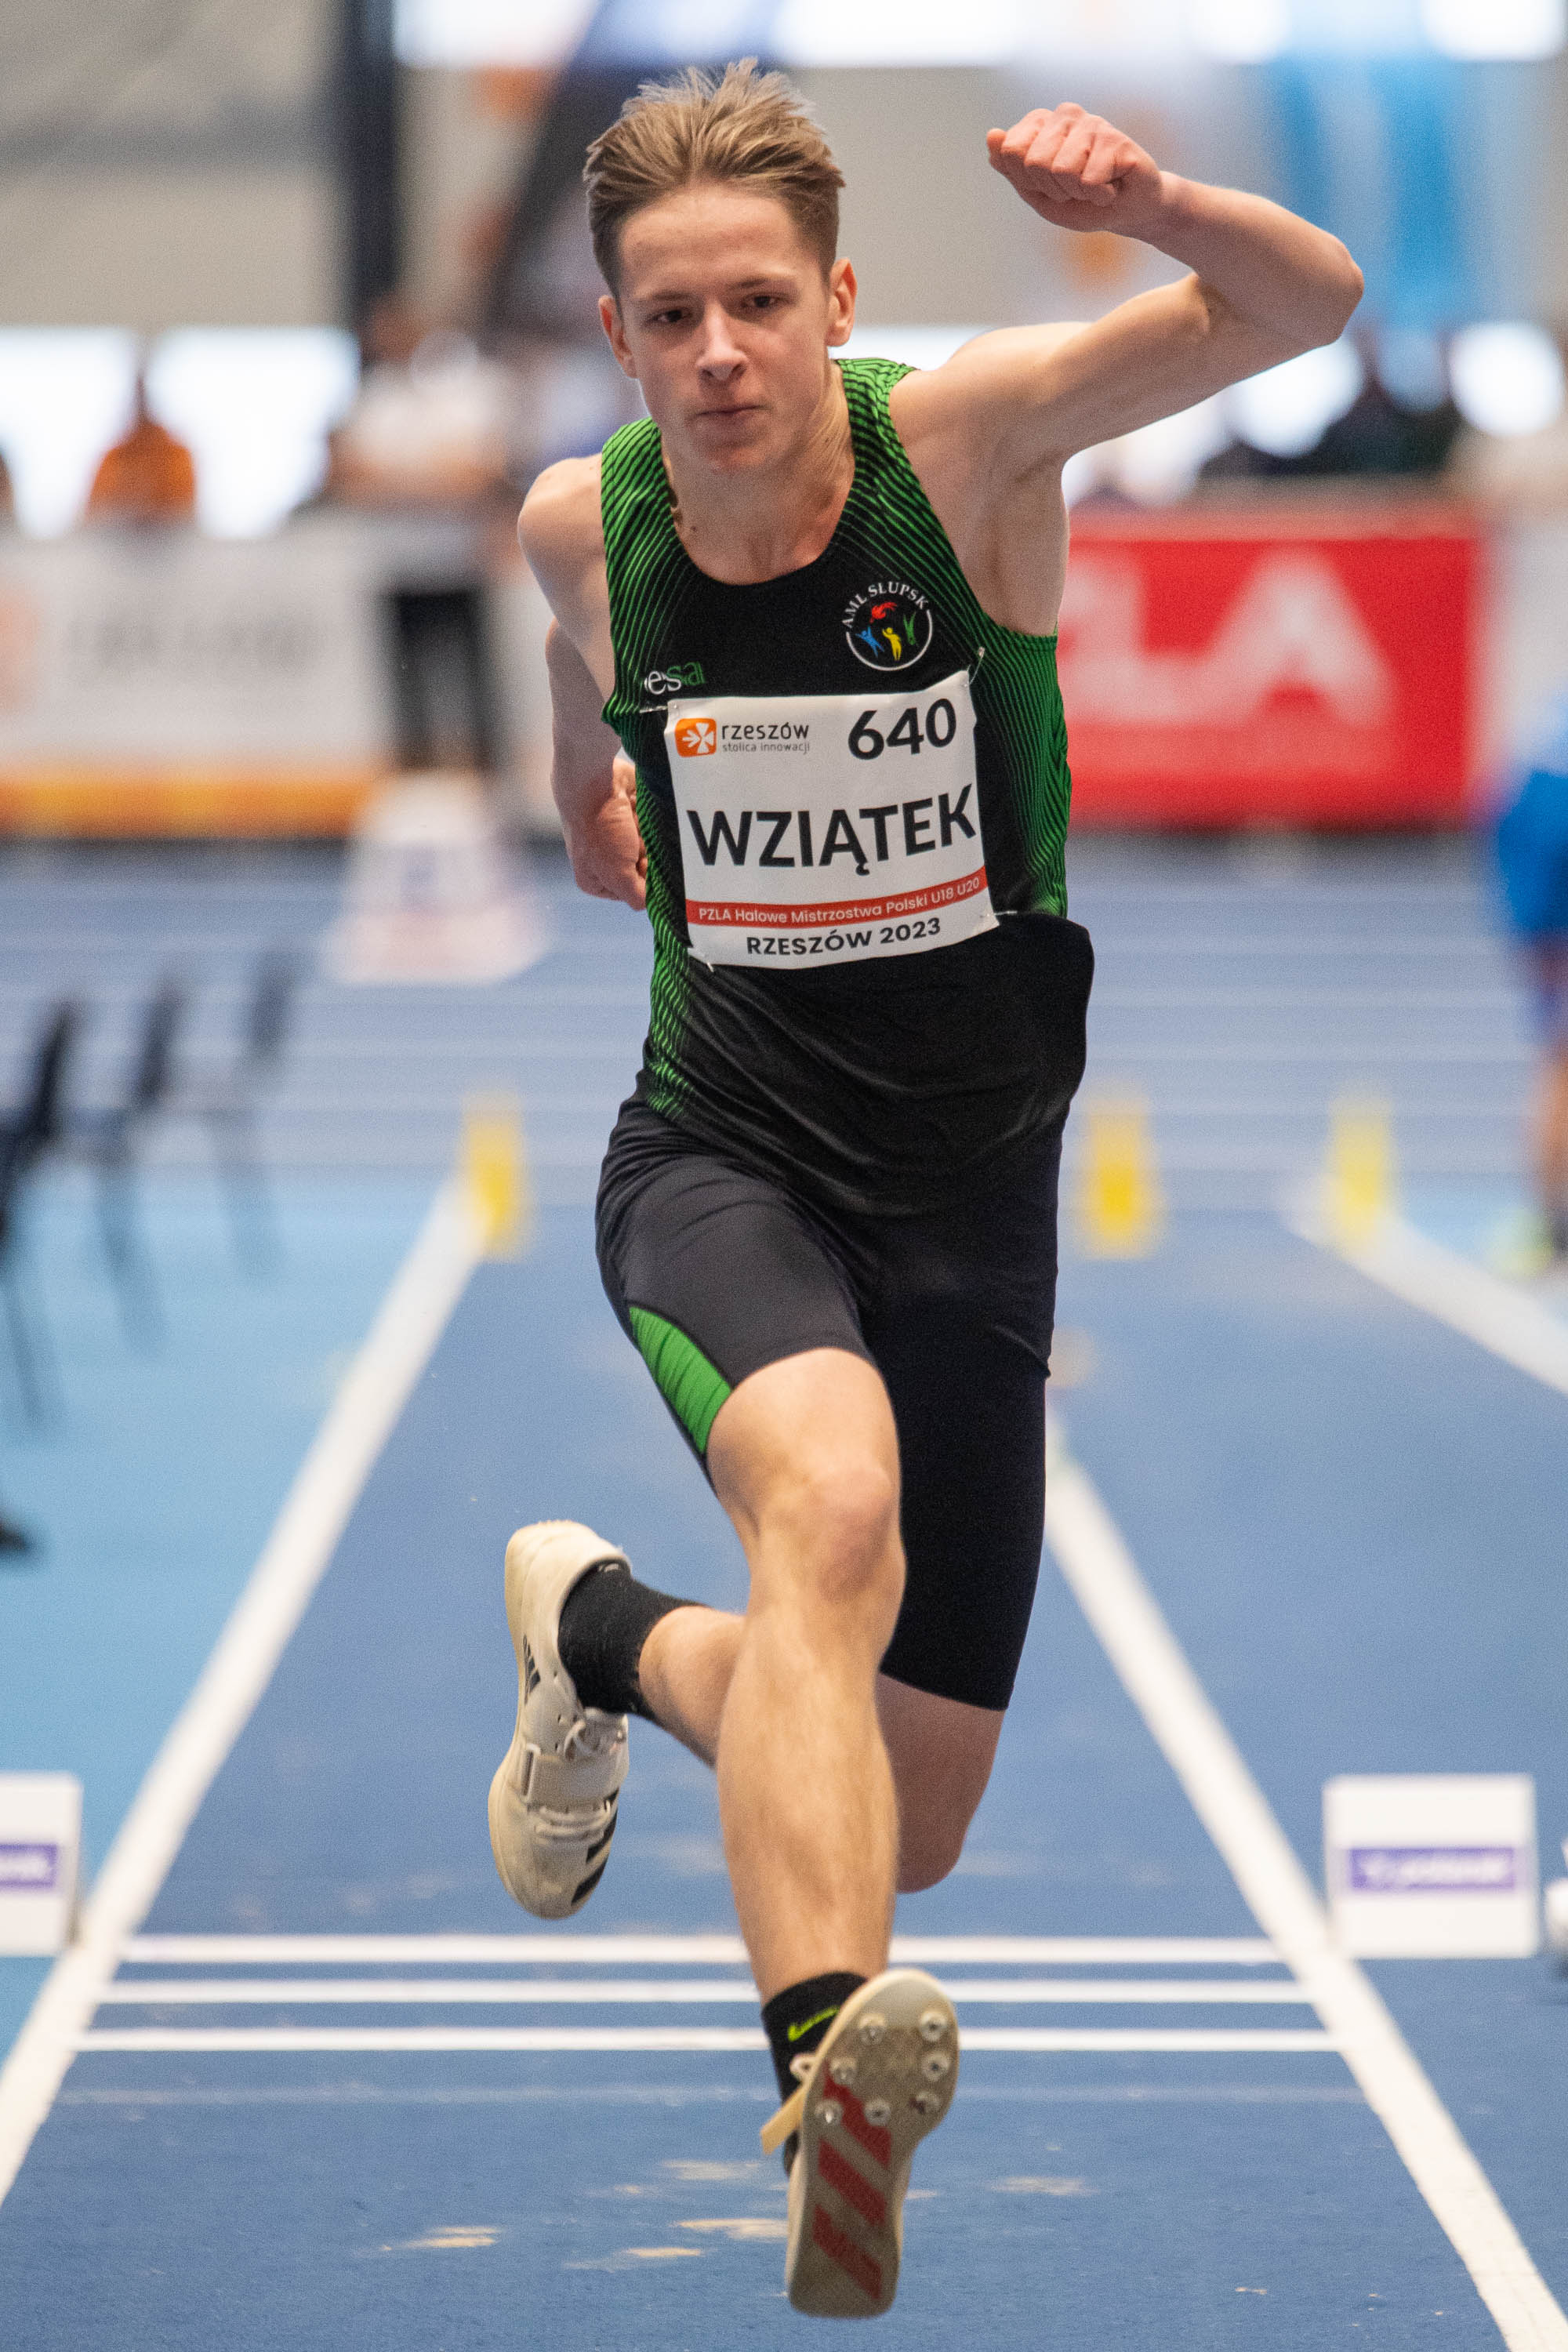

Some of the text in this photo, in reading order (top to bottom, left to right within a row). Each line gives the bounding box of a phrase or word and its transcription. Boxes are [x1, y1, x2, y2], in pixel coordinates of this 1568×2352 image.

[1058, 549, 1399, 725] LA
[722, 721, 809, 740] rzeszów
[722, 742, 810, 754] stolica innowacji
[848, 698, 956, 760] 640
[687, 783, 976, 877] WZIĄTEK
[699, 877, 979, 923] PZLA Halowe Mistrzostwa Polski U18 U20
[746, 917, 941, 956] RZESZÓW 2023
